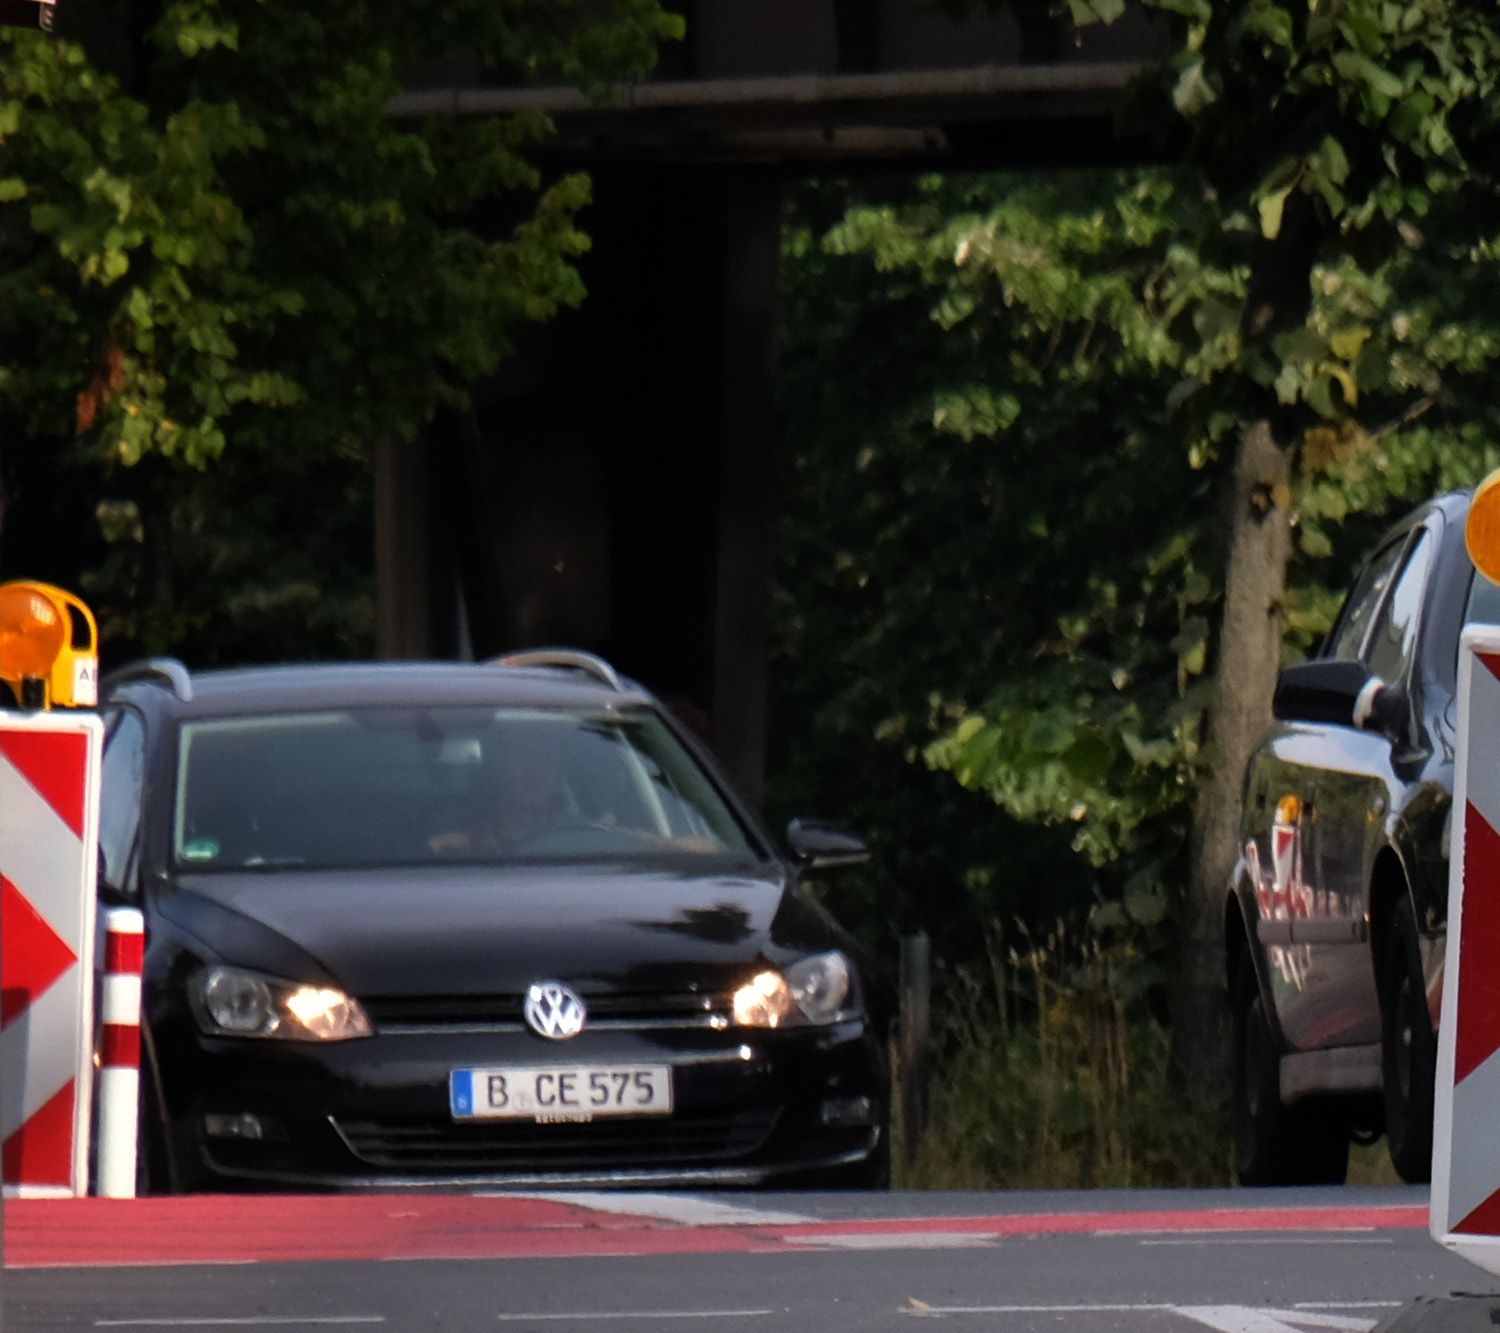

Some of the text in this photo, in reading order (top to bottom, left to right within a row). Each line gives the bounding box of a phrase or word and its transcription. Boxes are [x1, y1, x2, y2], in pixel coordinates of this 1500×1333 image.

[486, 1072, 655, 1108] B CE 575
